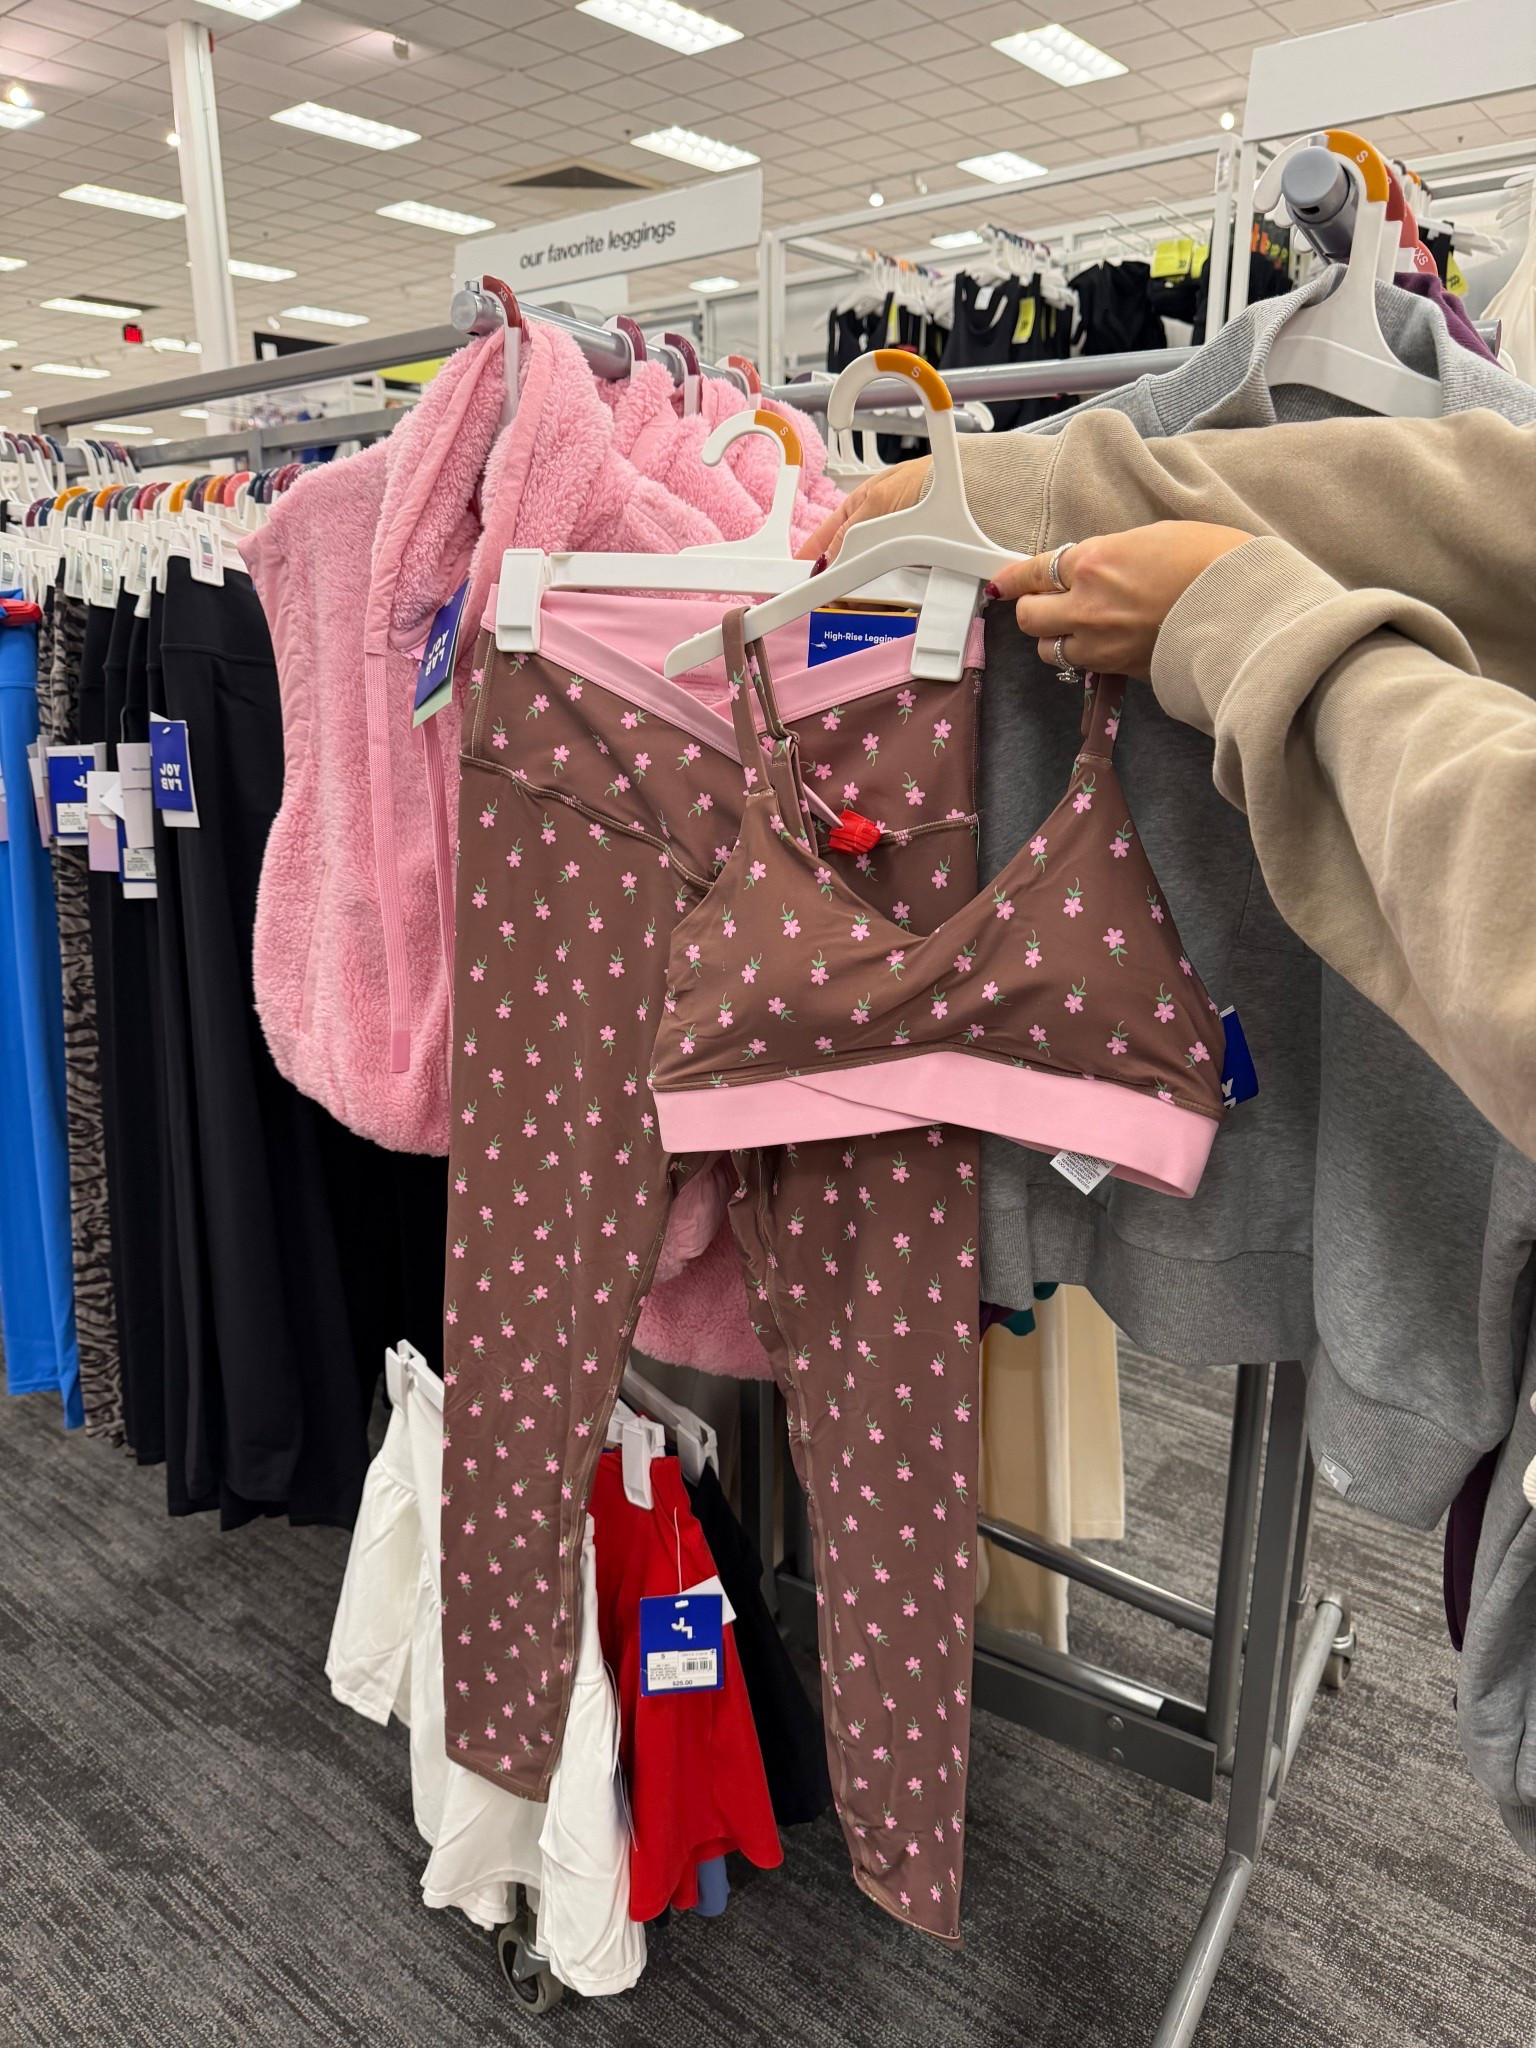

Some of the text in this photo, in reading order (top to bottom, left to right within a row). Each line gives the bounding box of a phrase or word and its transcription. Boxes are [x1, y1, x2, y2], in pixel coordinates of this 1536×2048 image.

[1356, 150, 1368, 163] S
[520, 220, 676, 269] our favorite leggings
[1414, 246, 1429, 266] XS
[499, 288, 508, 302] XS
[911, 365, 921, 378] S
[780, 426, 788, 436] S
[428, 629, 449, 659] JOY
[824, 631, 898, 644] High-Rise Leggin
[160, 763, 180, 777] JOY
